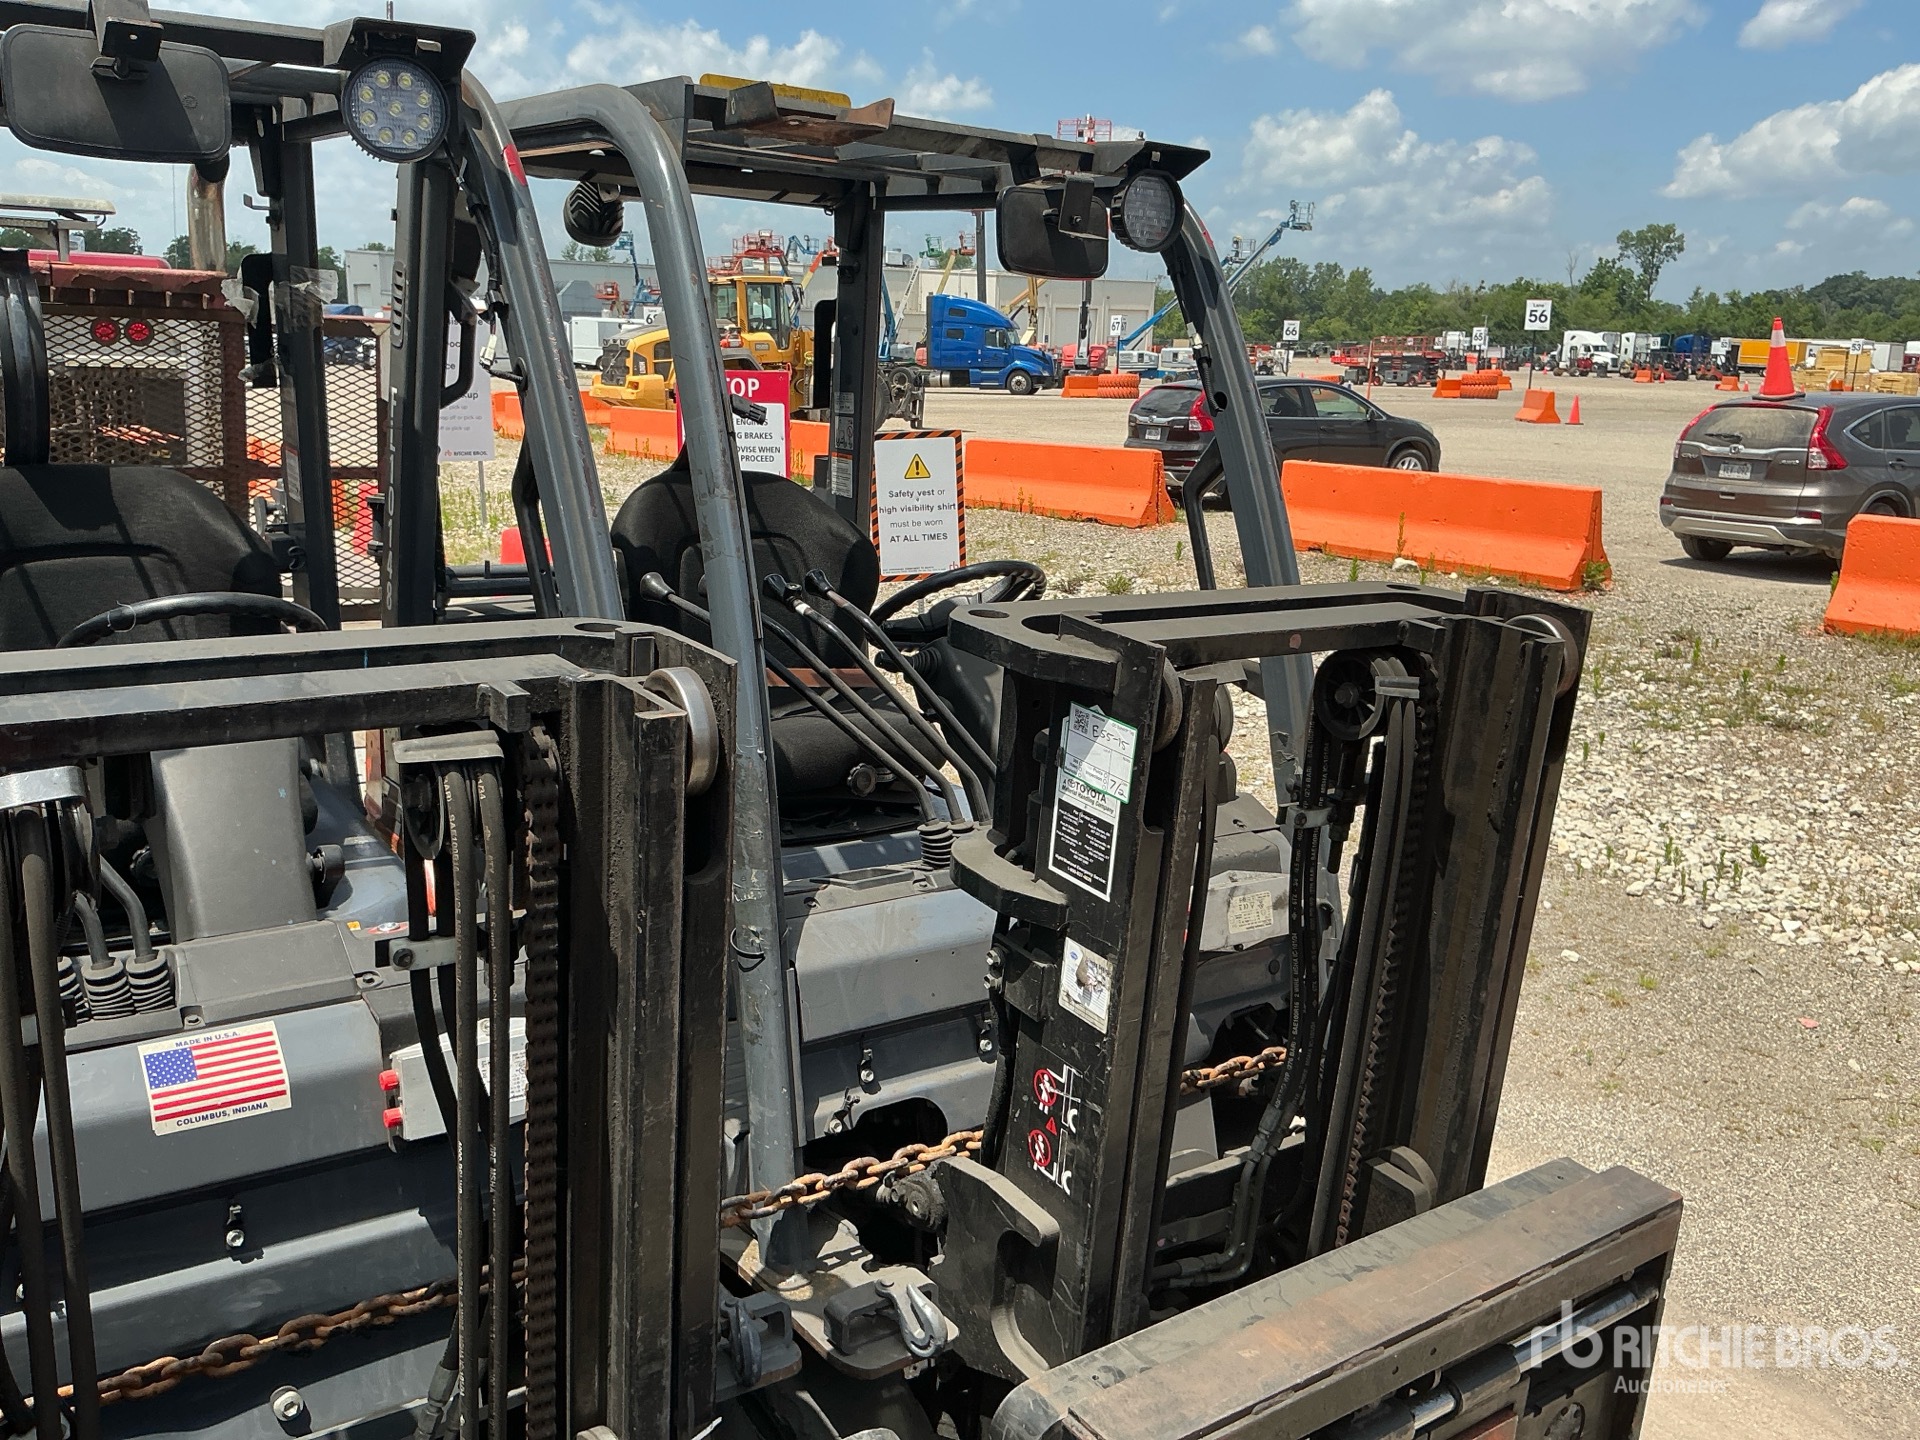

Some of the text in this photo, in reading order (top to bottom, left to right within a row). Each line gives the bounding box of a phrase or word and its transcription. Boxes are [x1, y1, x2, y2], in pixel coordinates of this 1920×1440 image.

[1528, 310, 1548, 323] 56
[1111, 322, 1120, 331] 67
[1285, 326, 1297, 336] 66
[1473, 333, 1484, 341] 65
[1851, 343, 1861, 351] 53
[744, 432, 773, 440] BRAKES
[758, 446, 780, 454] WHEN
[888, 490, 914, 499] Safety
[879, 502, 956, 514] high visibility shirt
[912, 519, 921, 527] be
[924, 519, 944, 527] worn
[890, 532, 948, 543] AT ALL TIMES
[1092, 725, 1130, 751] E55-15
[1076, 780, 1107, 804] TOYOTA
[1095, 799, 1114, 814] Company
[175, 1038, 201, 1048] MADE
[215, 1031, 241, 1040] U.S.A.
[176, 1101, 269, 1127] COLUMBUS, INDIANA
